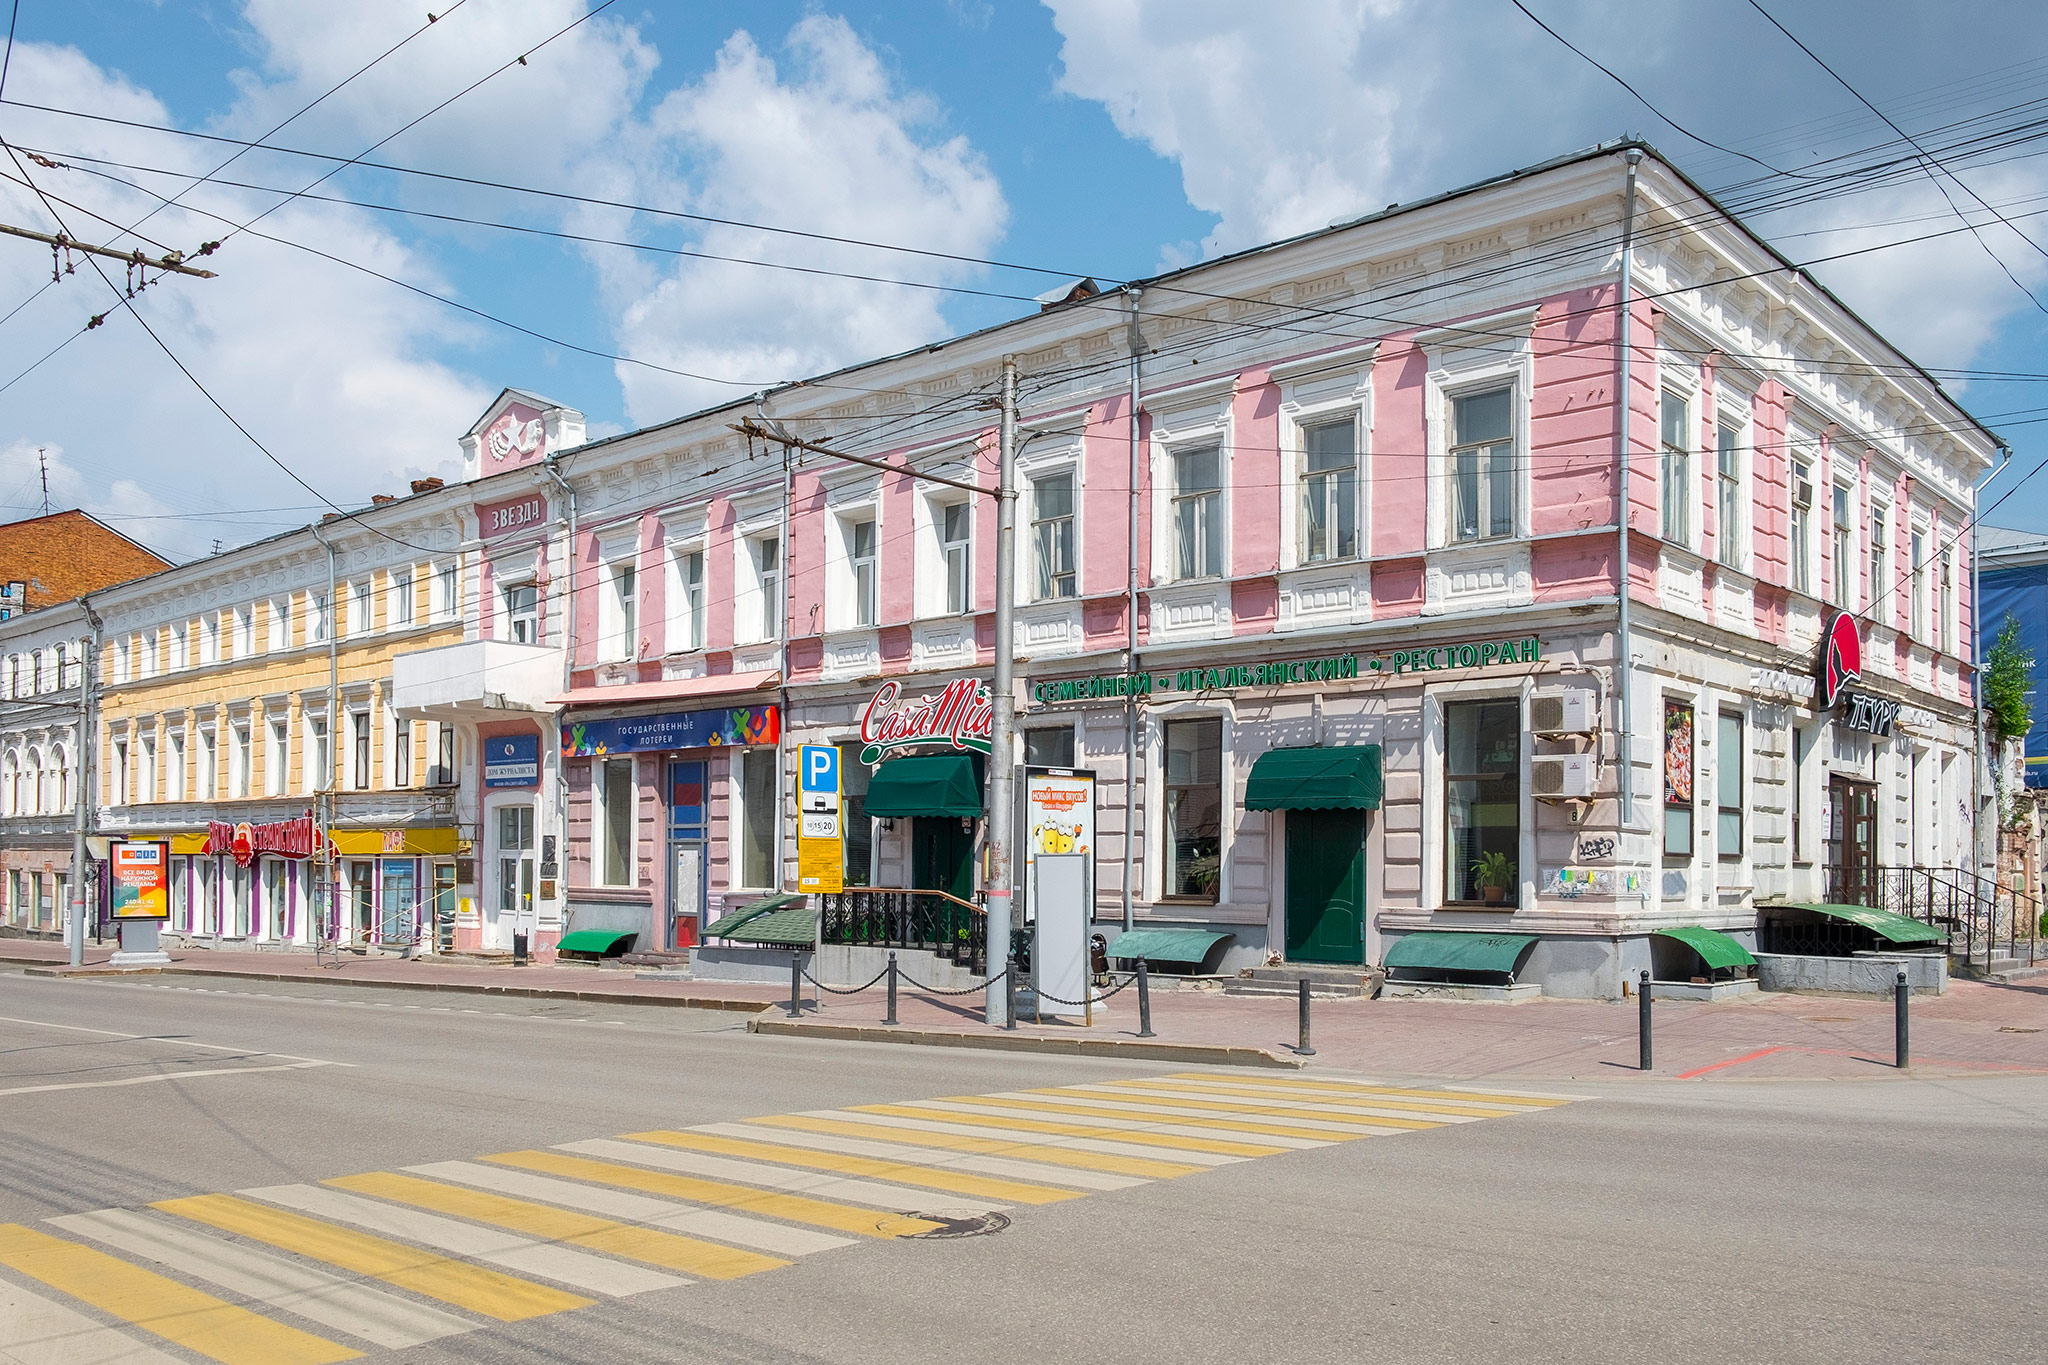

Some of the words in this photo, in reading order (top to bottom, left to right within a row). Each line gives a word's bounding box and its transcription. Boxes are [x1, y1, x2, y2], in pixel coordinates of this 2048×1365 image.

[491, 500, 539, 530] ЗВЕЗДА
[1034, 671, 1151, 702] СЕМЕЙНЫЙ
[1176, 653, 1358, 691] ИТАЛЬЯНСКИЙ
[1393, 639, 1540, 673] РЕСТОРАН
[860, 681, 930, 743] Casa
[921, 677, 992, 749] Mia
[617, 721, 694, 736] ГОСУДАРСТВЕННЫЕ
[639, 735, 673, 745] ЛОТЕРЕИ
[1572, 812, 1578, 821] 8
[814, 822, 821, 831] 15
[823, 821, 832, 831] 20
[383, 830, 406, 852] КАФЕ
